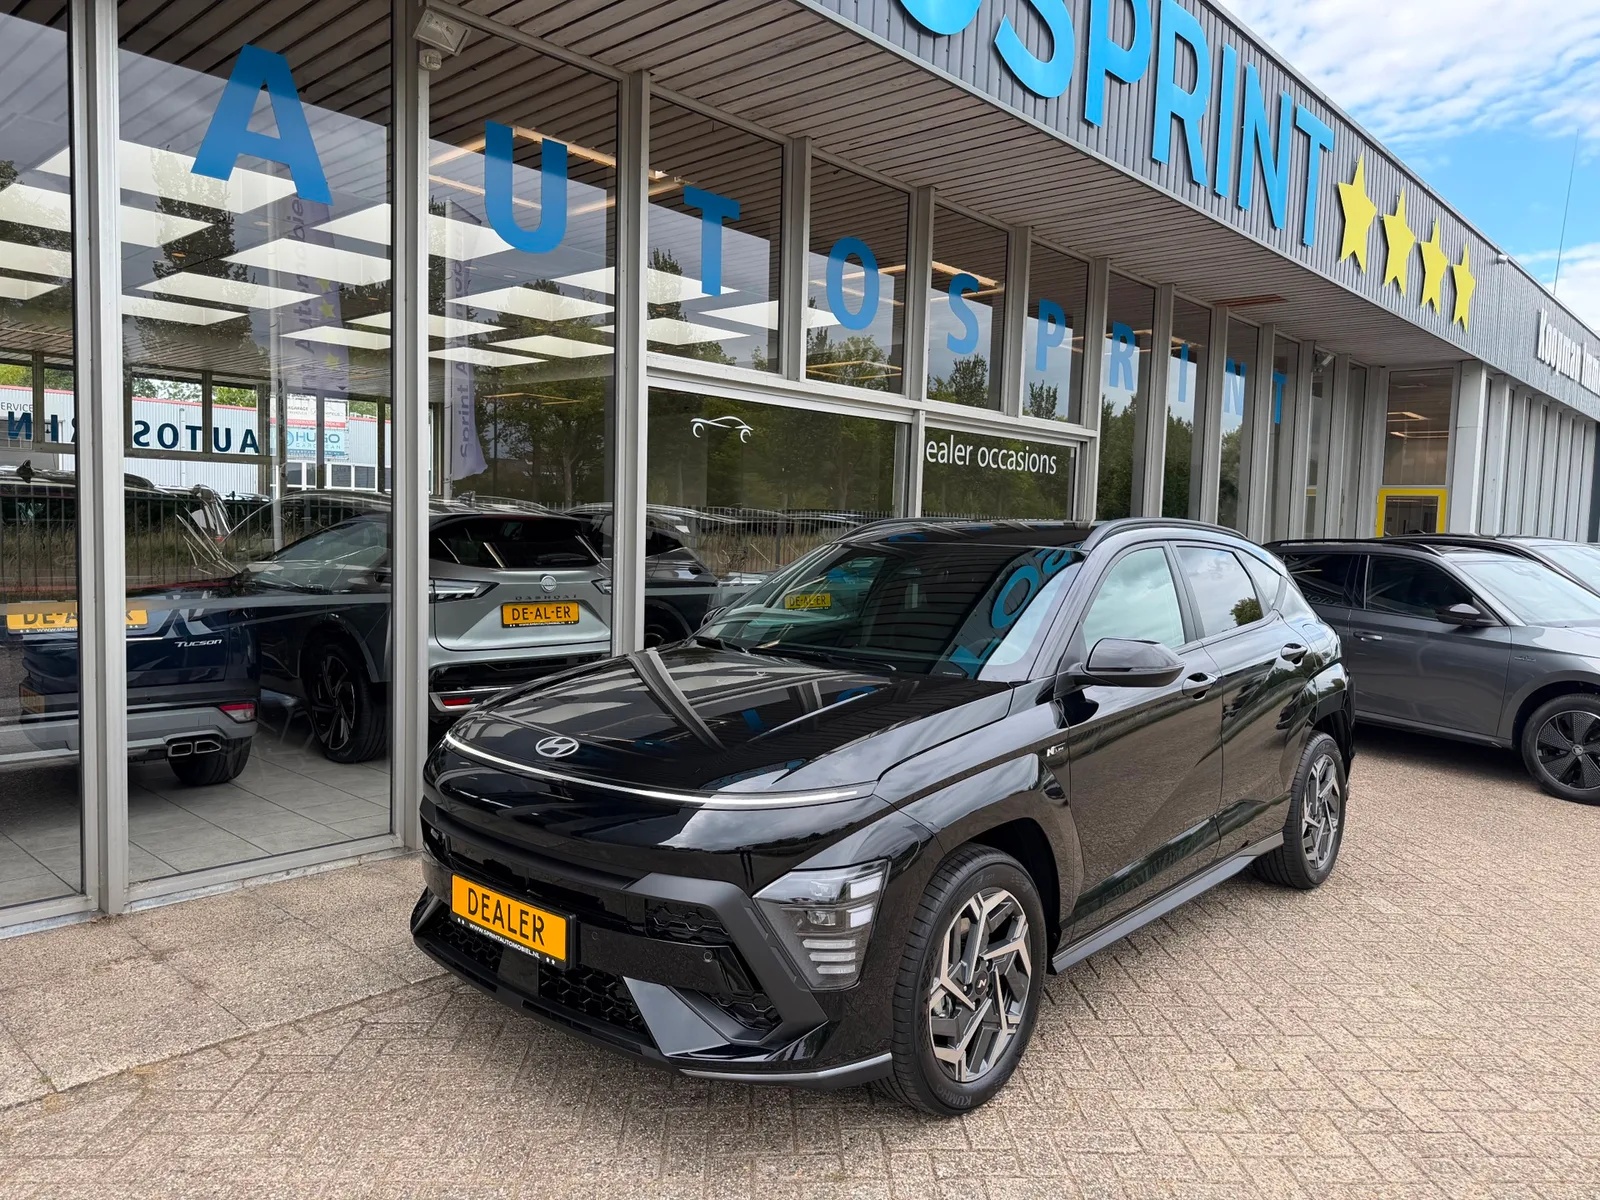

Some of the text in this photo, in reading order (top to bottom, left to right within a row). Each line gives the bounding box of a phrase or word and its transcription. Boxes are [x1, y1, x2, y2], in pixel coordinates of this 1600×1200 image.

[905, 0, 1334, 247] SPRINT
[1537, 307, 1581, 383] Koopman
[457, 384, 469, 459] Sprint
[926, 434, 1057, 475] ealer occasions
[512, 606, 571, 621] DE-AL-ER
[468, 888, 545, 946] DEALER
[936, 1084, 972, 1106] KUMHO
